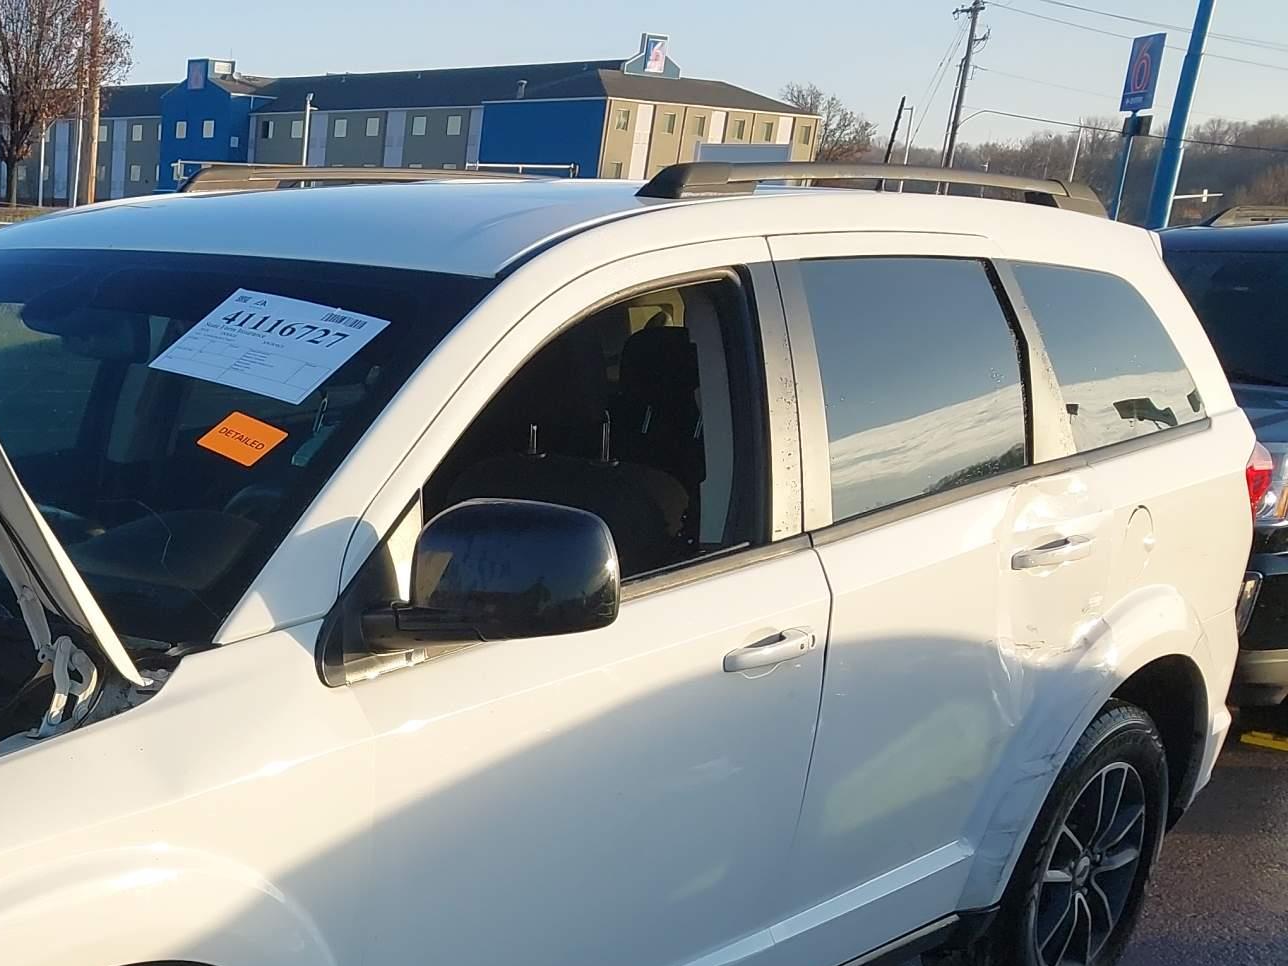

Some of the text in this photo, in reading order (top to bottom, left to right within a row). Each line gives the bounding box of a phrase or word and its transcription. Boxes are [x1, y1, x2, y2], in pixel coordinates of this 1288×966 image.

[1132, 41, 1152, 92] 6
[222, 310, 350, 348] 41116727
[218, 426, 265, 450] DETAILED
